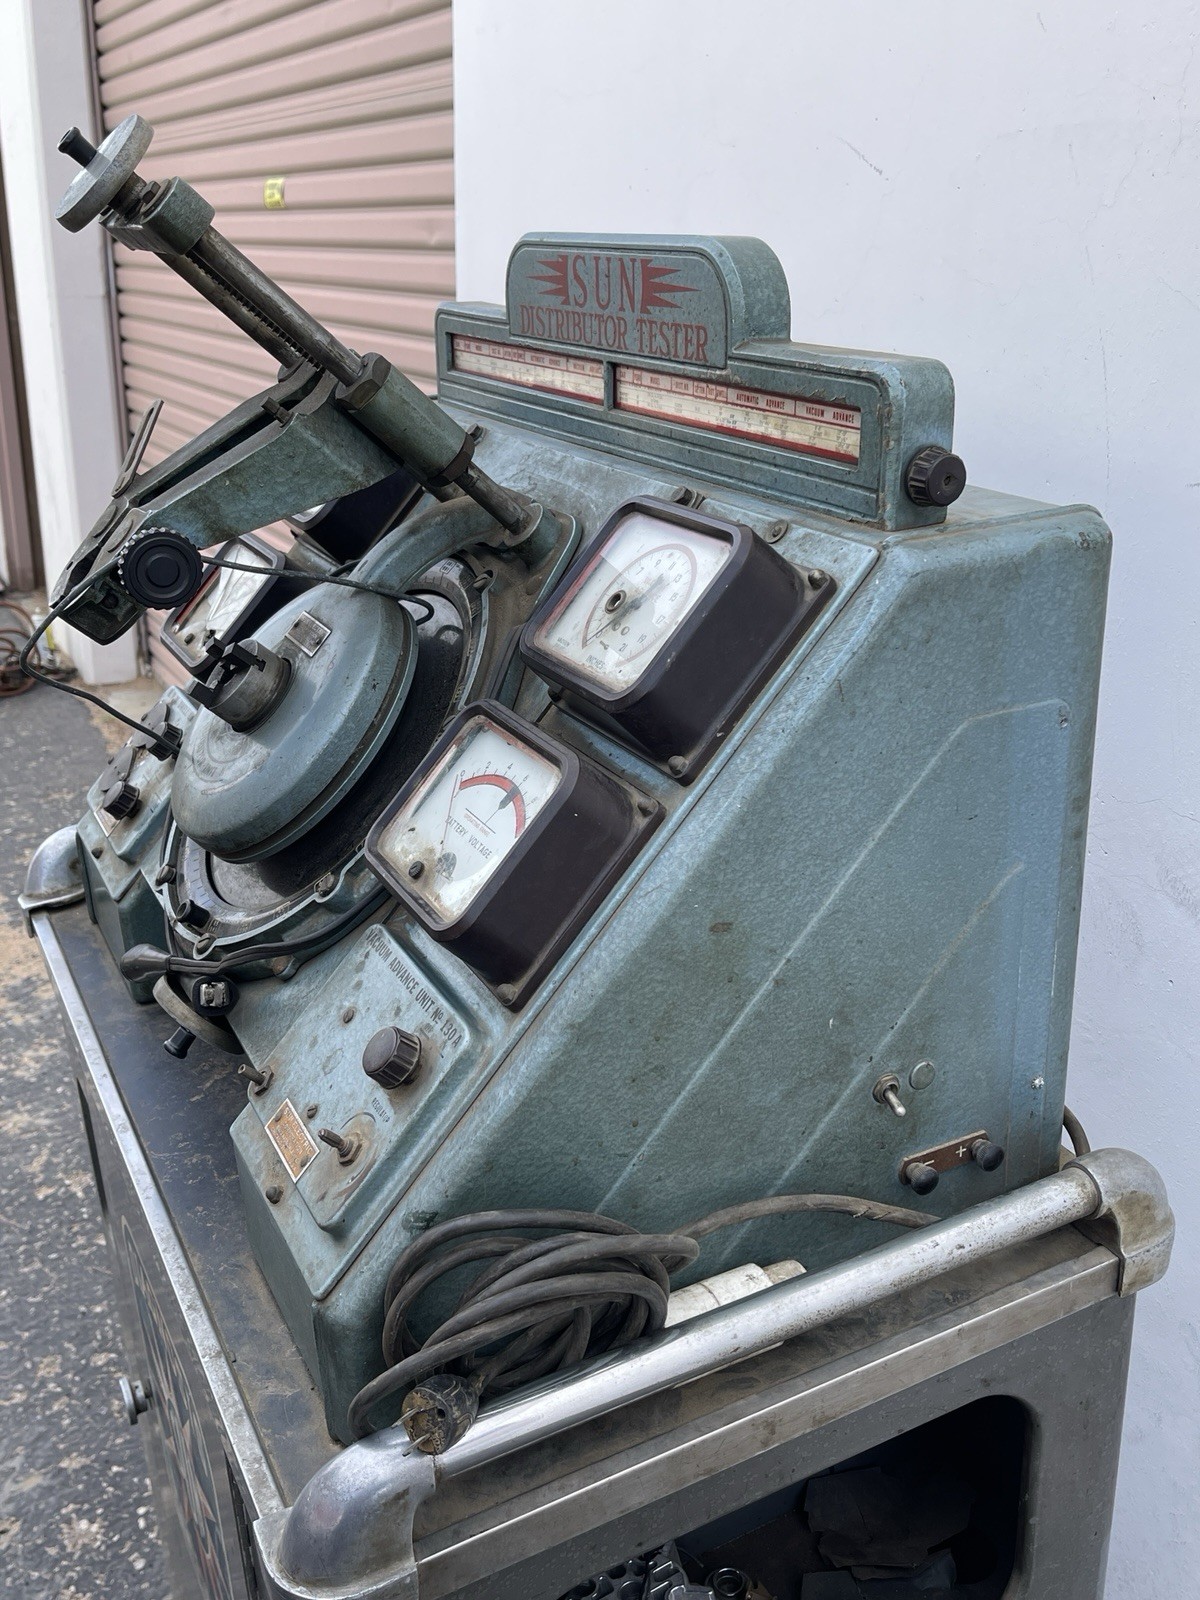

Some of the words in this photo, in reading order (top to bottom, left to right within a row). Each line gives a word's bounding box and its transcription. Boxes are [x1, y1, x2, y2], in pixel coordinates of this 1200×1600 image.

[572, 254, 637, 313] SUN
[519, 304, 629, 351] DISTRIBUTOR
[636, 318, 709, 363] TESTER
[736, 392, 759, 405] AUTOMATIC
[765, 398, 785, 410] ADVANCE
[805, 406, 825, 418] VACUUM
[832, 411, 855, 424] ADVANCE
[460, 769, 466, 777] 0
[485, 761, 492, 769] 2
[468, 836, 492, 859] VOLTAGE
[365, 928, 393, 963] VACUUM
[388, 957, 419, 995] ADVANCE
[415, 988, 436, 1012] UNIT
[291, 1121, 313, 1155] ELECTRIC
